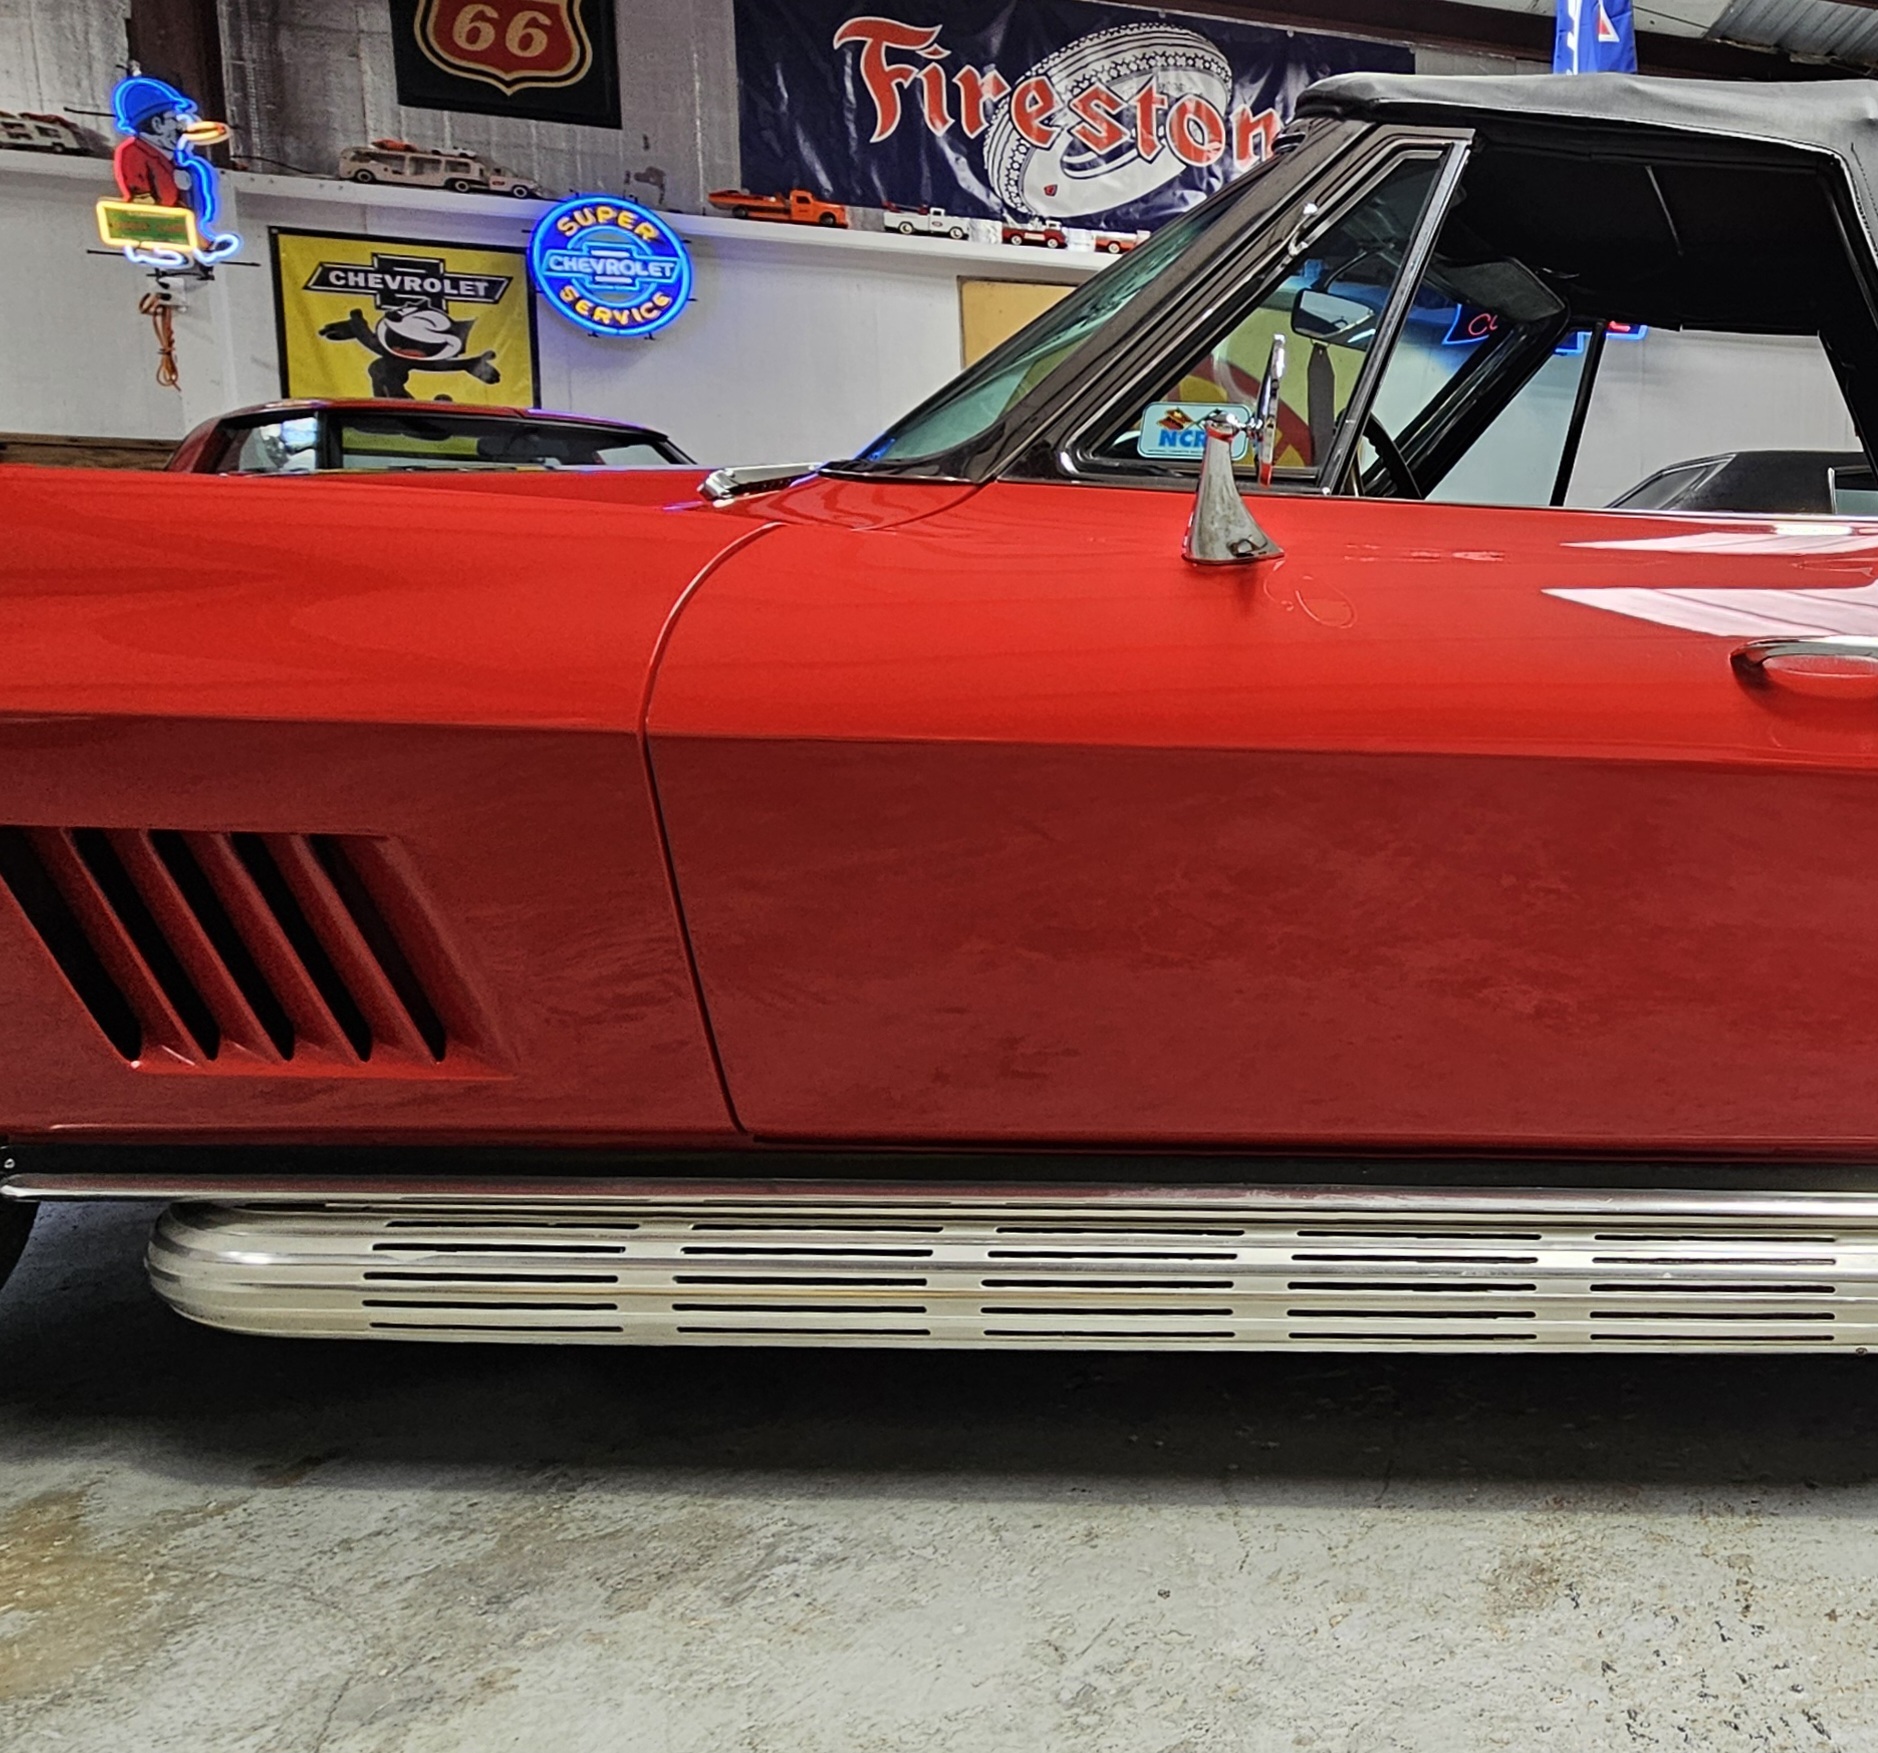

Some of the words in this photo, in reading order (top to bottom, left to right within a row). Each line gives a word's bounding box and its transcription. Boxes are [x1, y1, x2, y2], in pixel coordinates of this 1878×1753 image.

[452, 3, 552, 58] 66
[833, 16, 1284, 172] Fireston
[556, 205, 660, 242] SUPER
[328, 270, 490, 297] CHEVROLET
[548, 254, 676, 277] CHEVROLET
[558, 284, 674, 326] SERVICE
[1158, 428, 1208, 448] NCR
